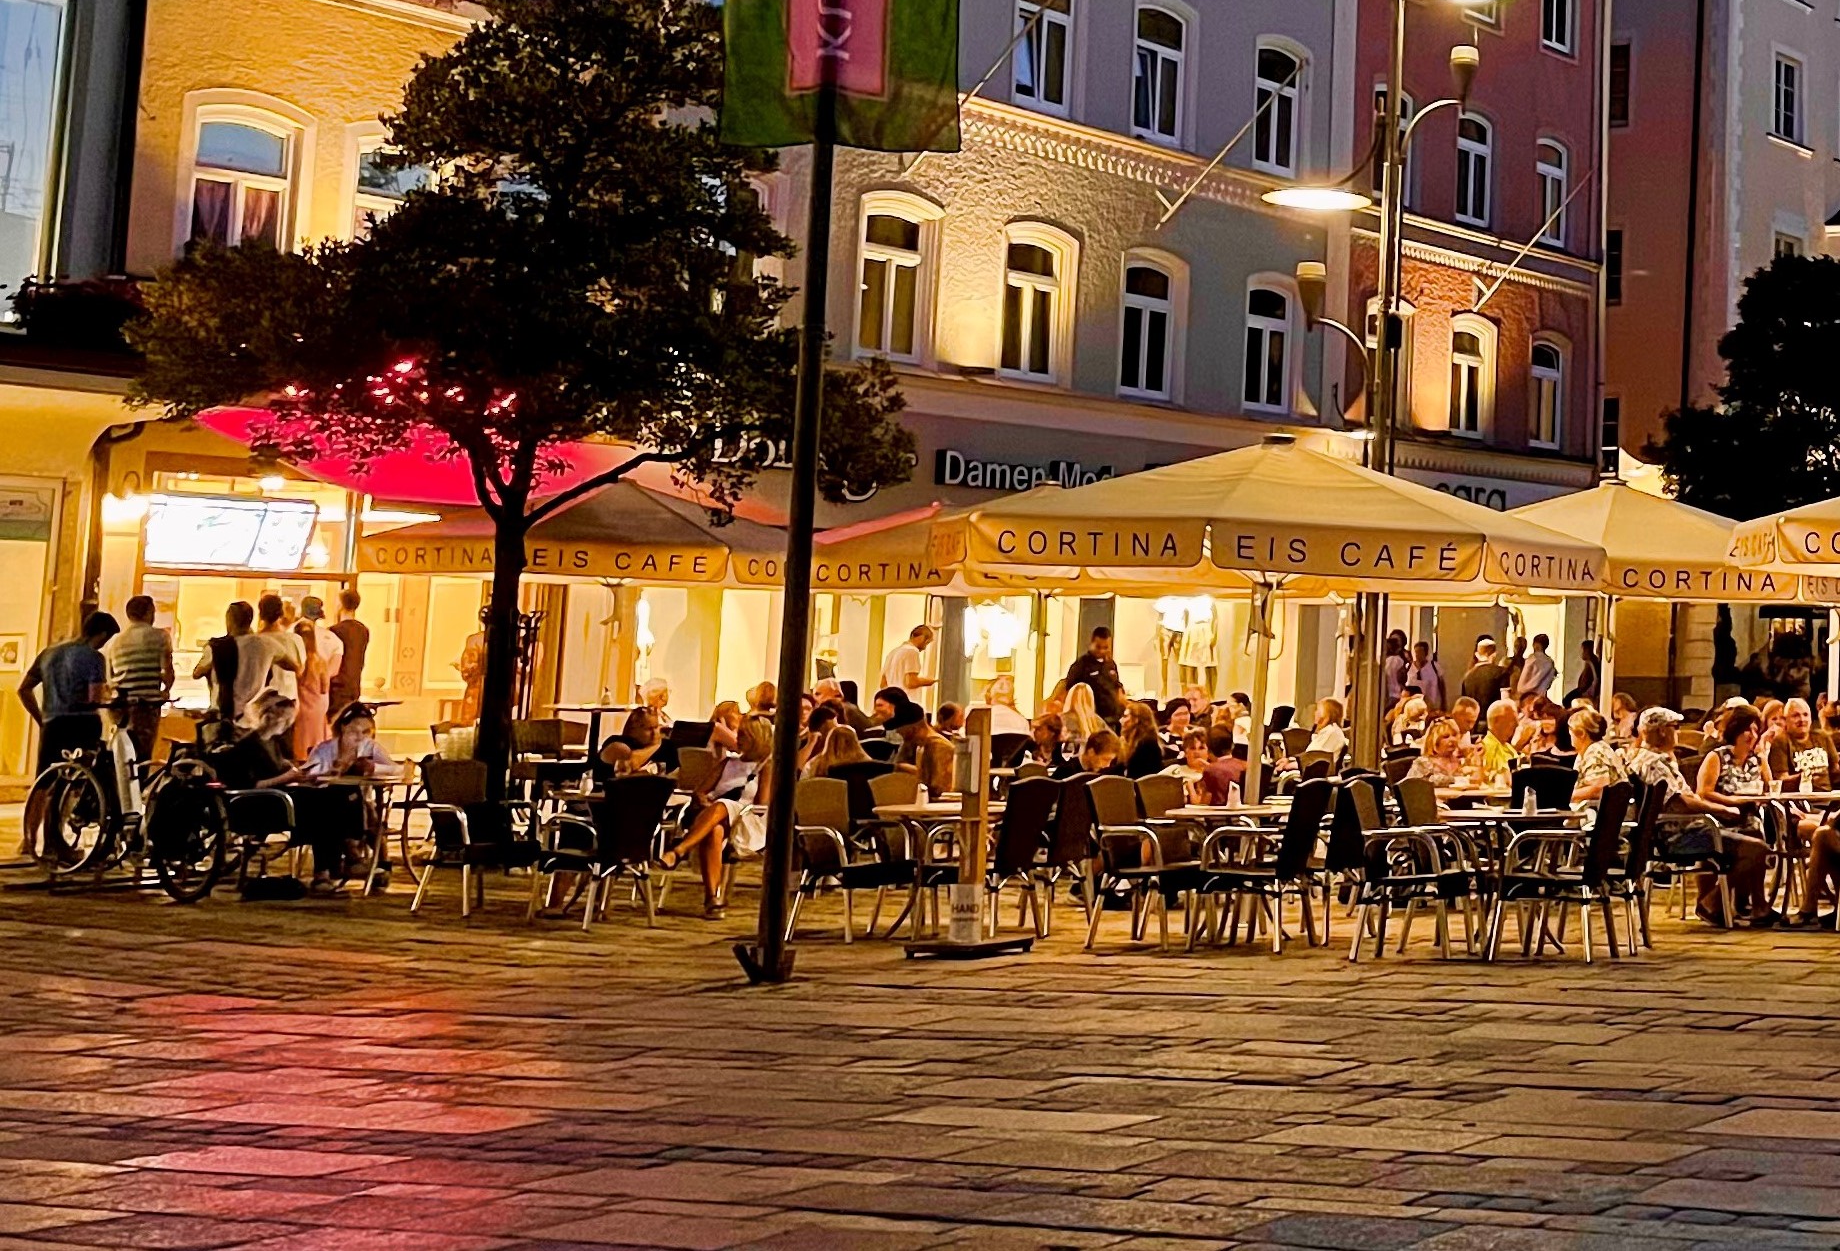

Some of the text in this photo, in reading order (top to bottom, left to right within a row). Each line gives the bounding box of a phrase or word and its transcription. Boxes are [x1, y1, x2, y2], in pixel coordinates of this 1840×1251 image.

[944, 450, 1046, 490] Damen
[376, 546, 493, 564] CORTINA
[998, 530, 1178, 557] CORTINA
[1236, 535, 1457, 571] EIS CAFÉ
[532, 548, 589, 568] EIS
[1500, 551, 1595, 582] CORTINA
[816, 562, 942, 582] CORTINA
[1623, 568, 1776, 593] CORTINA
